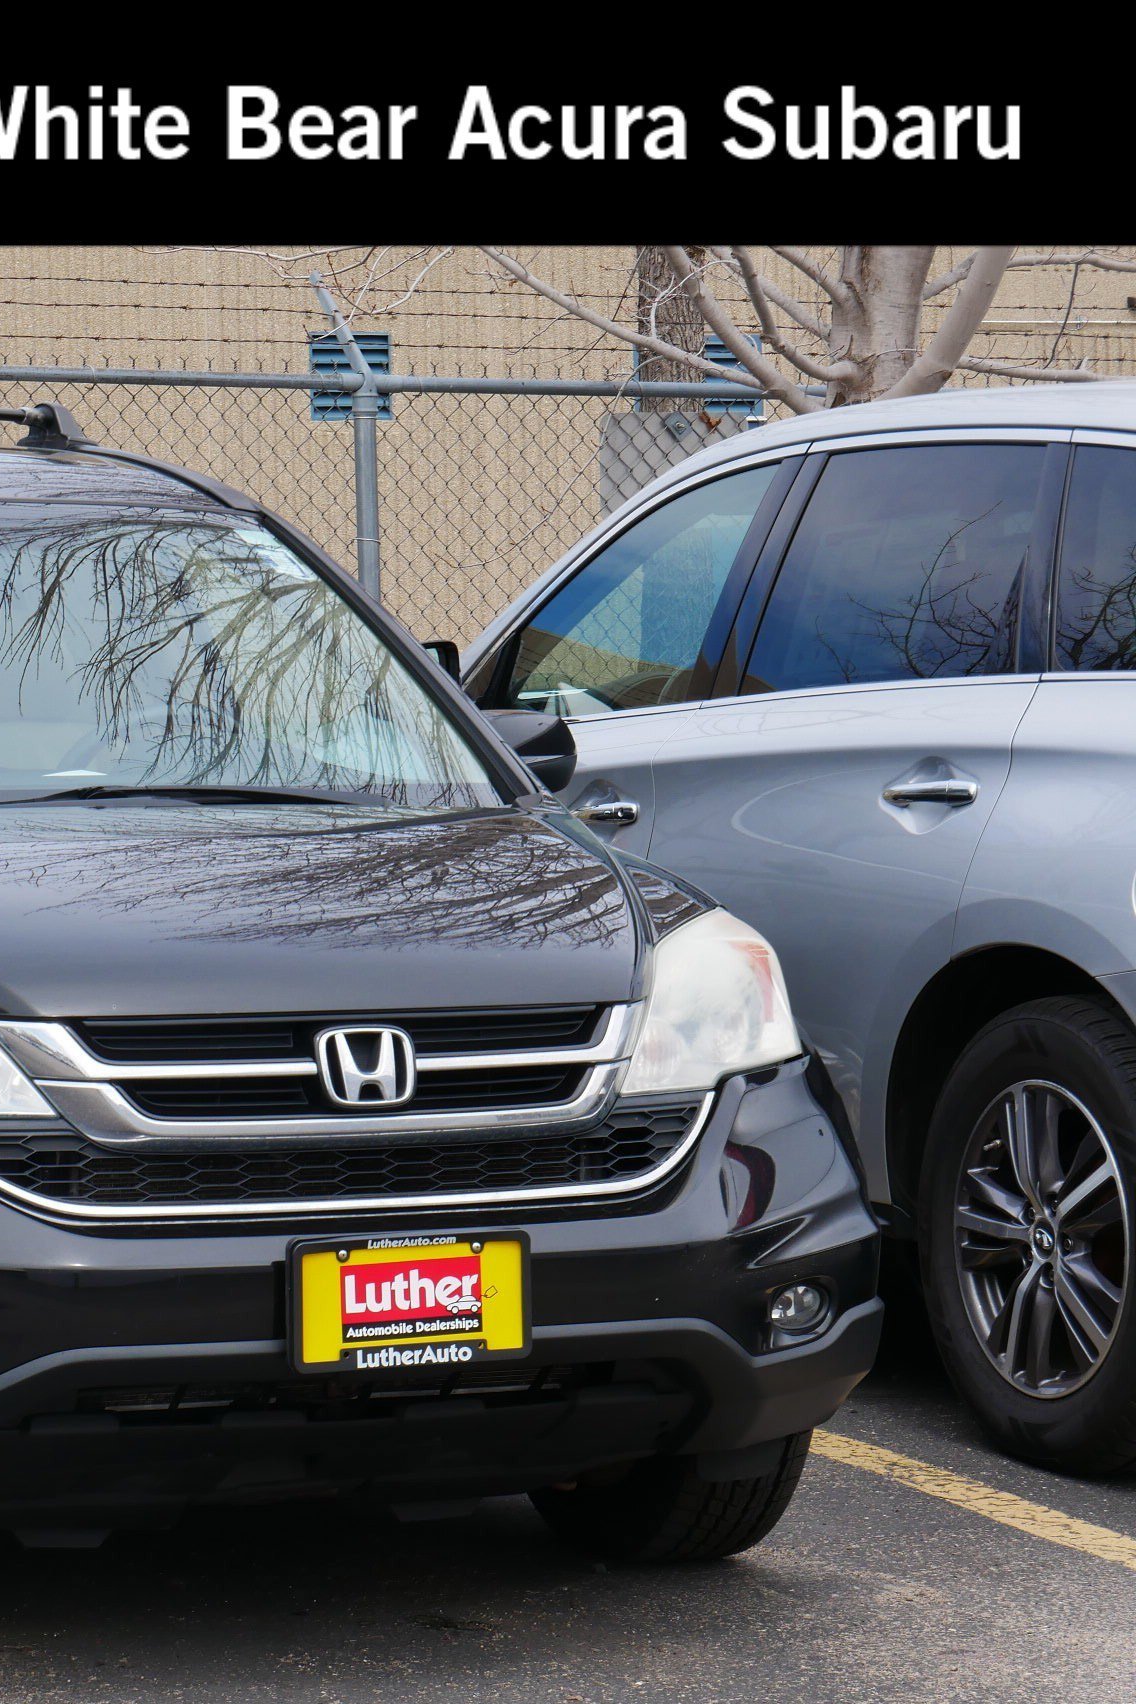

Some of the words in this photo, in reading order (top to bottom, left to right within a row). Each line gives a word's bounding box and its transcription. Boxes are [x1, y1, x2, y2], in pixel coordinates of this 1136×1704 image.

[367, 1235, 457, 1250] LutherAuto.com
[344, 1268, 479, 1314] Luther
[346, 1322, 414, 1338] Automobile
[415, 1317, 480, 1333] Dealerships
[356, 1343, 473, 1369] LutherAuto
